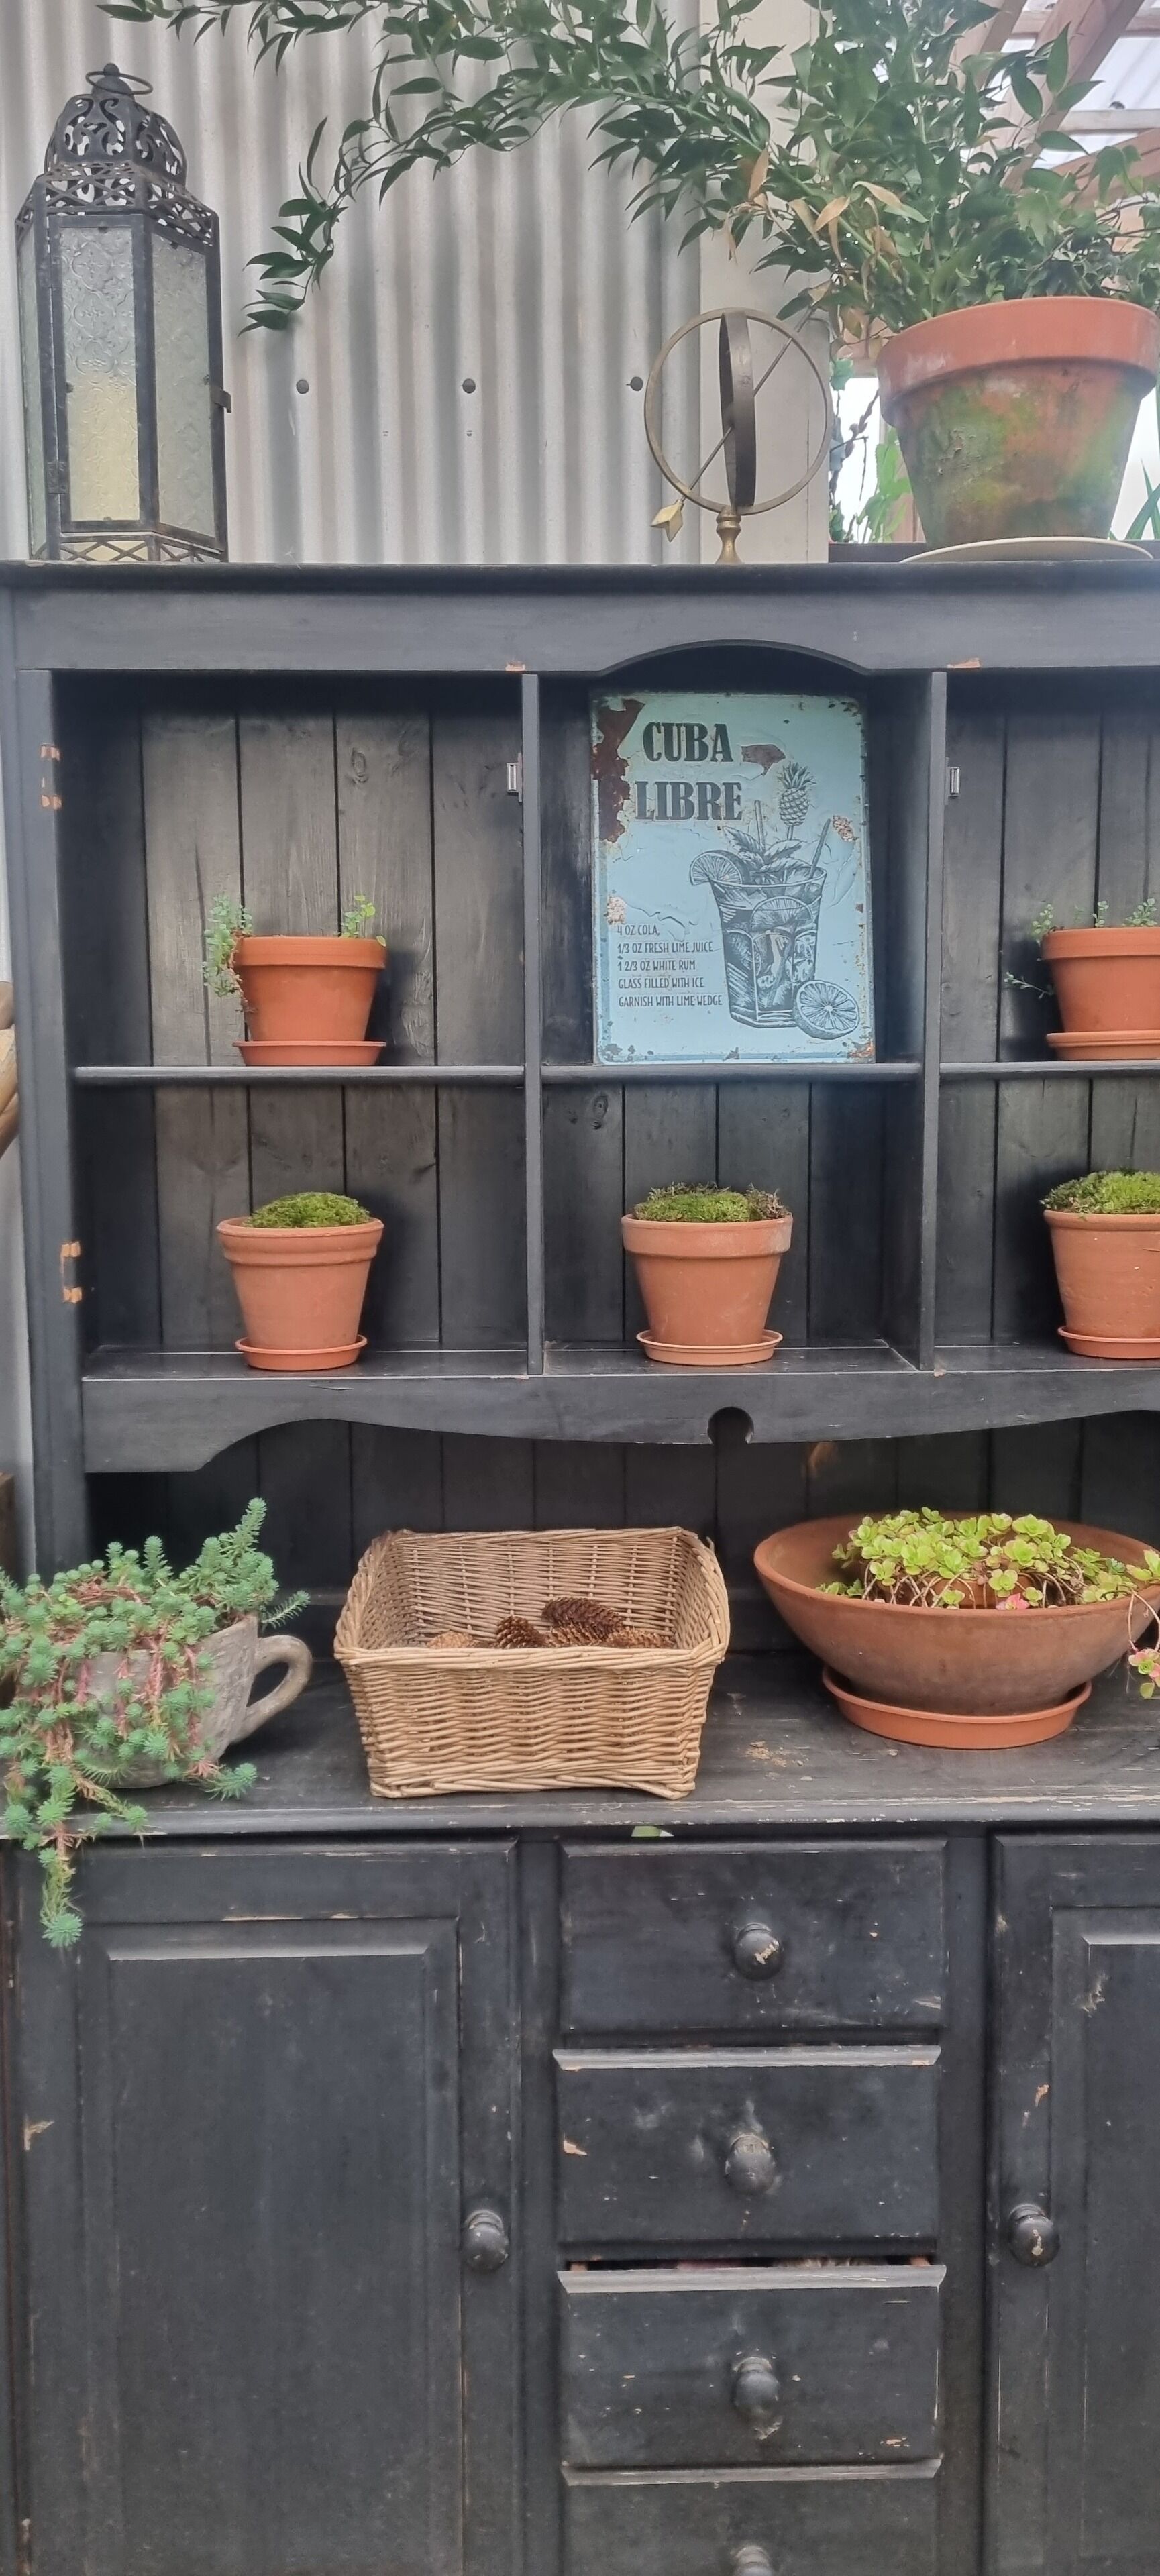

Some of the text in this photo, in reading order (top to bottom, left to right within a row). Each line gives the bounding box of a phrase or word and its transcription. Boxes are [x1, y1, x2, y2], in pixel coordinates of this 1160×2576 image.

[642, 722, 733, 763] CUBA
[635, 781, 743, 821] LIBRE
[617, 924, 660, 936] 4 OZ COLA,
[617, 941, 714, 954] 1/3 OZ FRESH LIME JUICE
[617, 959, 696, 971] 1 2/3 OZ WHITE RUM
[618, 977, 705, 989] GLASS FILLED WITH ICE
[619, 995, 723, 1007] GARNISH WITH LIME WEDGE
